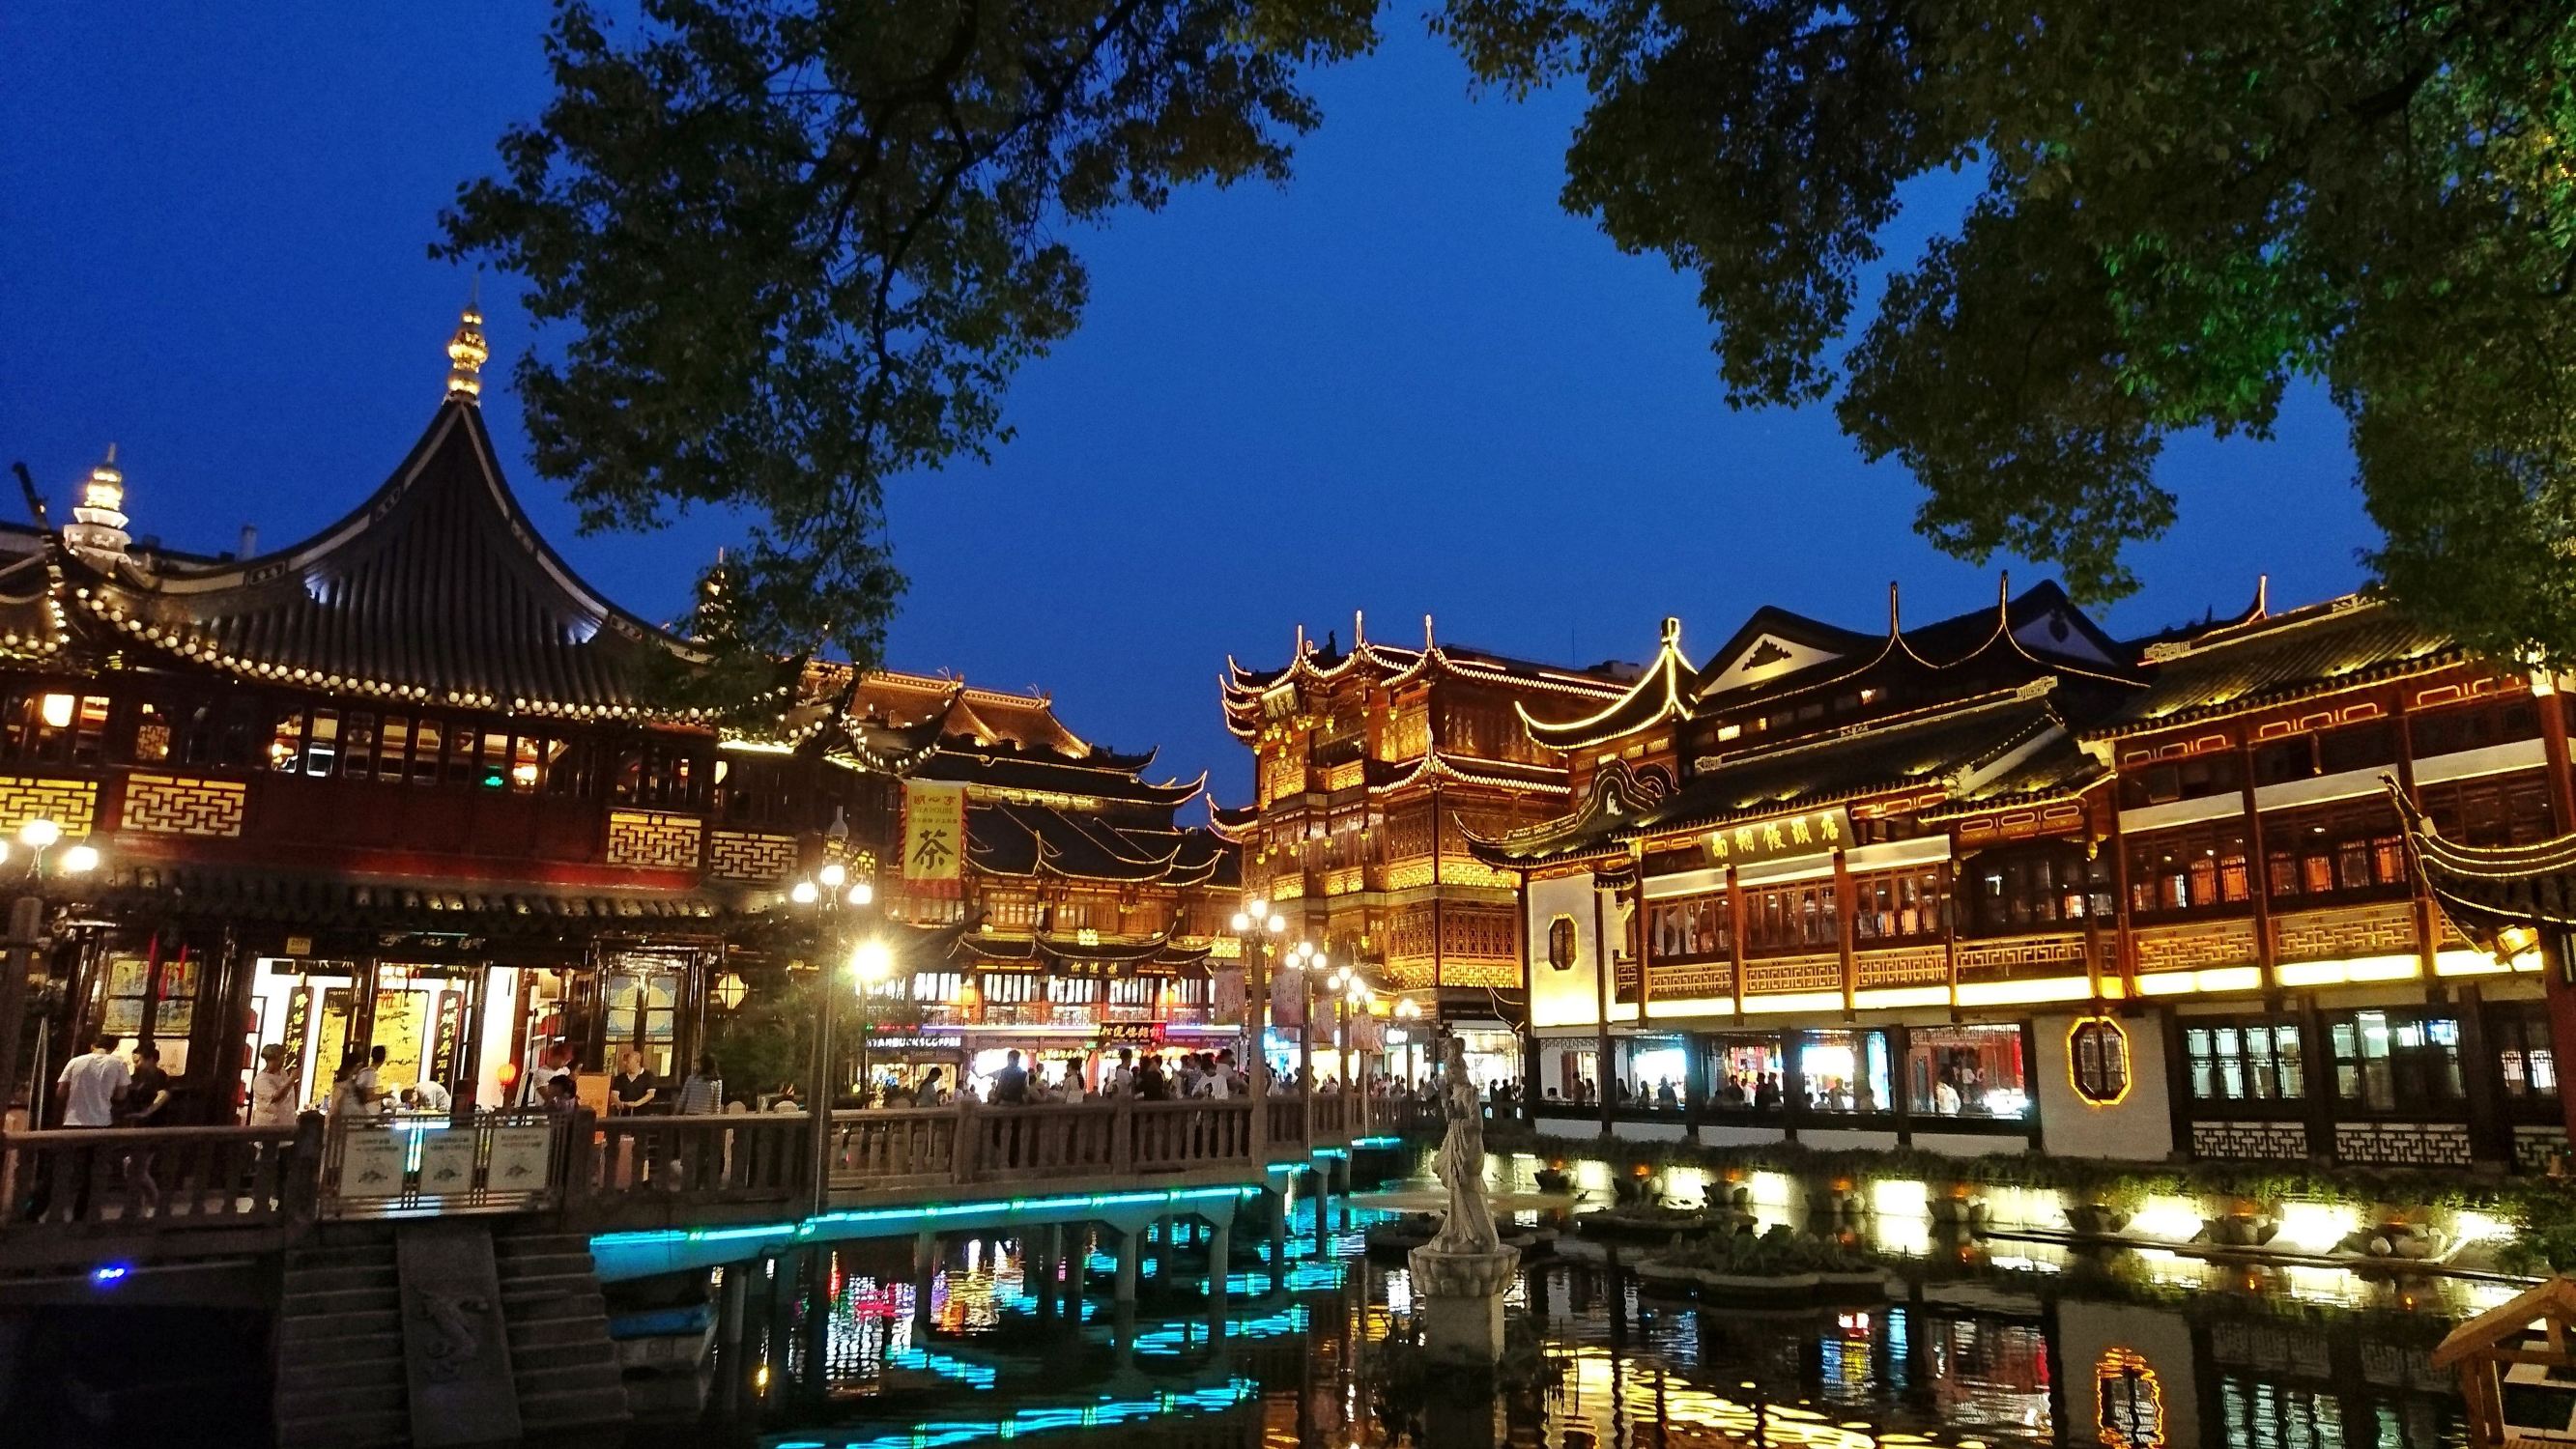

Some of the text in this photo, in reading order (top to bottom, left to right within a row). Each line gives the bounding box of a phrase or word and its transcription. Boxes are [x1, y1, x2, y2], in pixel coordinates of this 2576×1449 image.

[912, 829, 954, 869] 茶
[866, 1037, 961, 1047] STARBUCKS COFFEE
